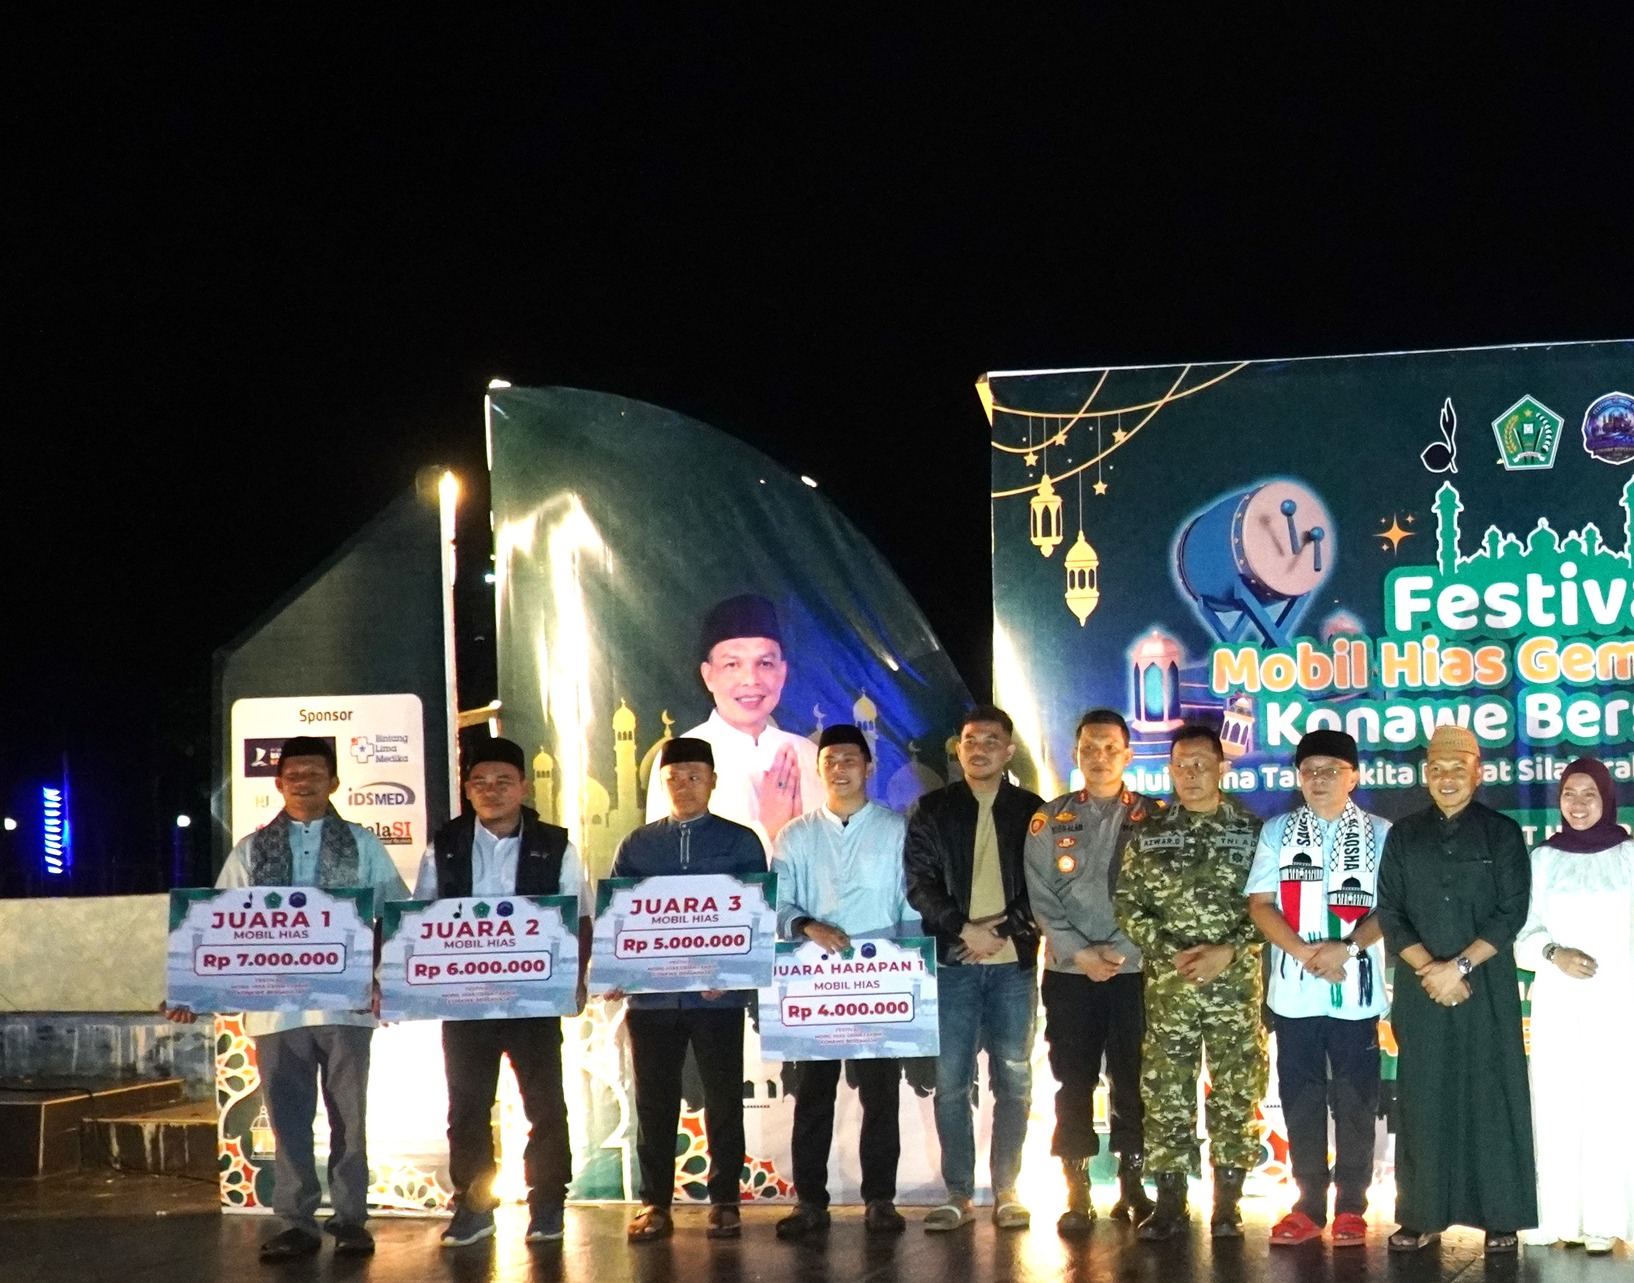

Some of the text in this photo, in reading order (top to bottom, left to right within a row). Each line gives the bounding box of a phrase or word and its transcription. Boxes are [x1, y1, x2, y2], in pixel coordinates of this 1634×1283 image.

[1212, 638, 1367, 694] Mobil
[1380, 635, 1507, 687] Hias
[299, 709, 354, 724] Sponsor
[1265, 700, 1508, 746] Konawe
[375, 734, 409, 744] Bintang
[376, 744, 397, 752] Lima
[376, 755, 409, 763] Medika
[1359, 761, 1414, 785] kita
[630, 896, 742, 915] JUARA 3
[211, 911, 331, 929] JUARA 1
[651, 914, 719, 925] MOBIL HIAS
[234, 929, 309, 940] MOBIL HIAS
[420, 919, 540, 939] JUARA 2
[444, 938, 516, 949] MOBIL HIAS
[623, 934, 745, 953] Rp 5.000.000
[203, 952, 338, 970] Rp 7.000.000
[414, 959, 546, 980] Rp 6.000.000
[831, 961, 912, 974] HARAPAN
[918, 960, 924, 971] 1
[814, 980, 880, 991] MOBIL HIAS
[788, 1001, 909, 1021] Rp 4.000.000
